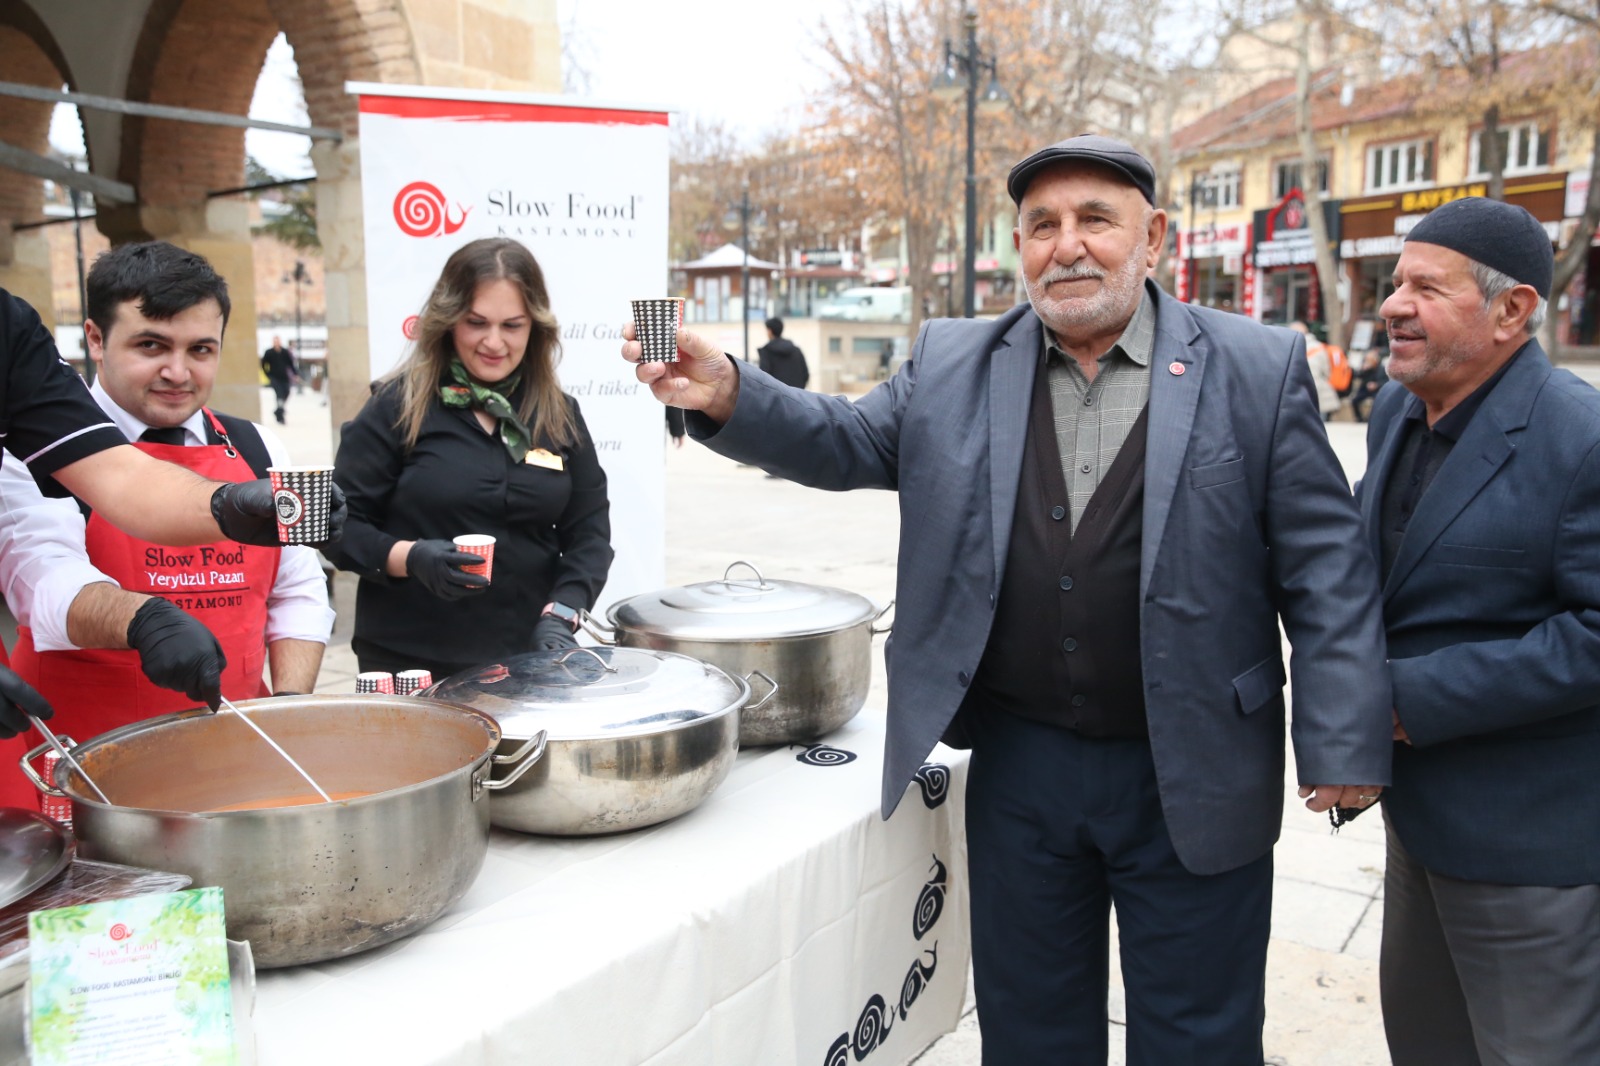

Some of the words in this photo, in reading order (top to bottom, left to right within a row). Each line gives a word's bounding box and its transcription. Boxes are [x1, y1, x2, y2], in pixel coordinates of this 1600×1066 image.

[487, 188, 554, 217] Slow
[566, 193, 635, 220] Food
[498, 225, 637, 238] KASTAMONU
[559, 323, 588, 340] dil
[592, 323, 626, 340] Gıd
[562, 379, 593, 396] erel
[598, 380, 639, 396] tüket
[593, 439, 622, 451] oru
[145, 547, 194, 567] Slow
[200, 545, 244, 566] Food
[168, 595, 242, 609] STAMONU
[88, 946, 119, 960] Slow
[70, 985, 90, 996] SLOW
[91, 982, 111, 992] FOOD
[113, 975, 157, 988] KASTAMONU
